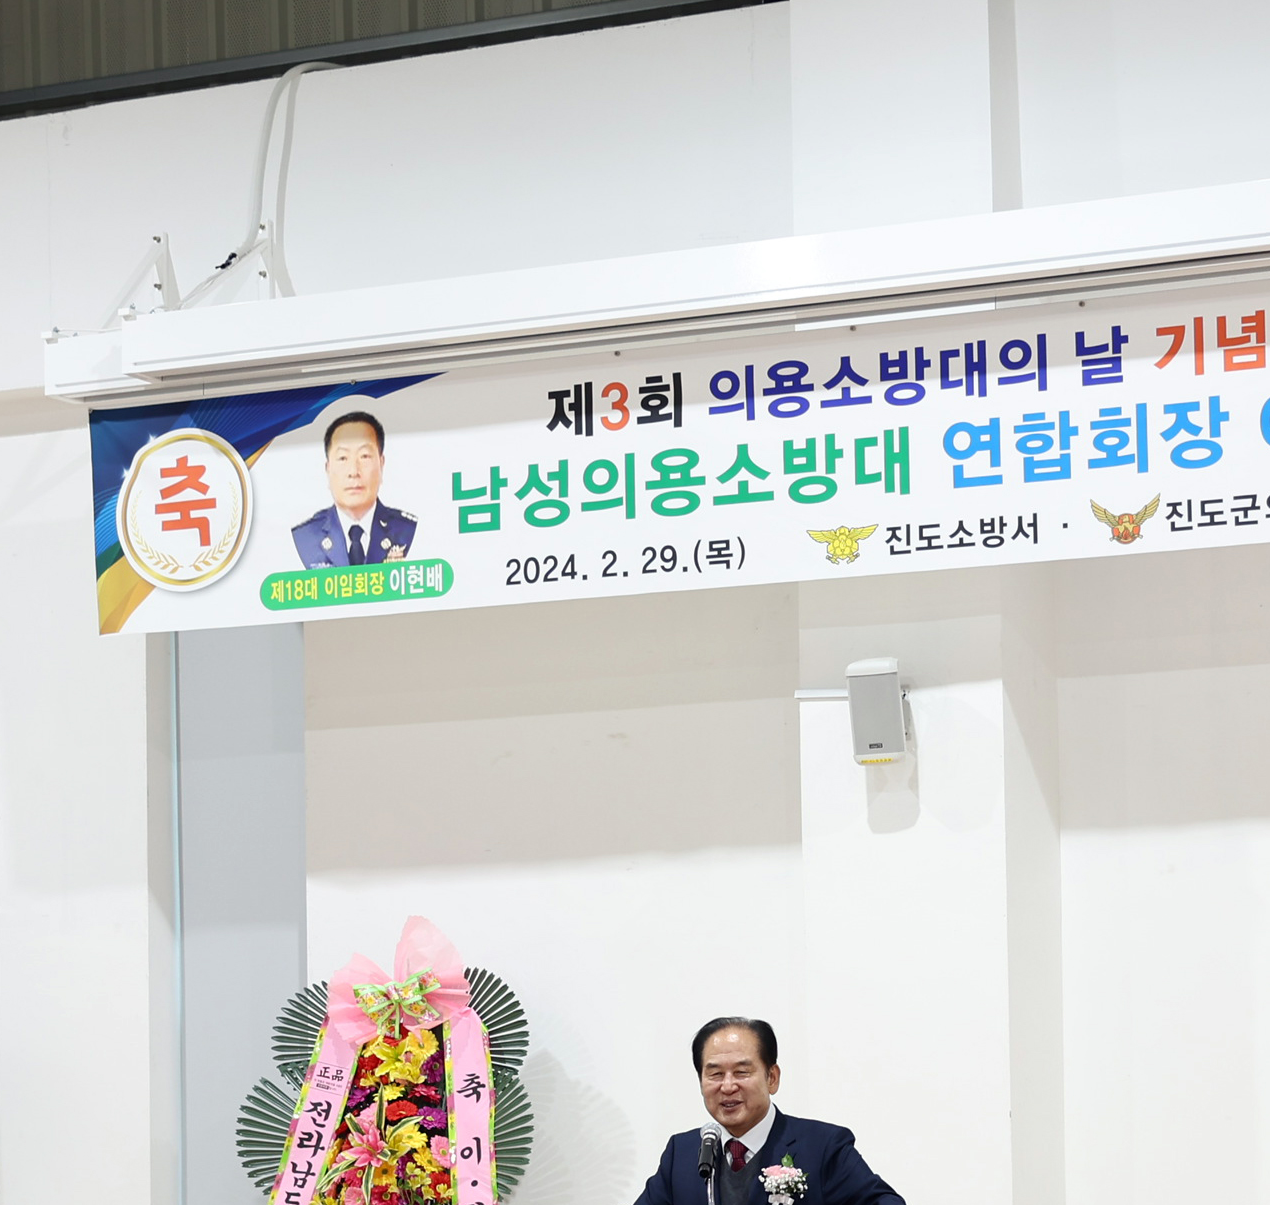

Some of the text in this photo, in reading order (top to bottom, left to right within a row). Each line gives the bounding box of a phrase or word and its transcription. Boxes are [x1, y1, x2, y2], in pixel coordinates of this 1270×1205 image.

[546, 371, 684, 437] 제3회
[708, 325, 1048, 421] 의용소방대의
[1075, 325, 1129, 382] 날
[452, 426, 911, 534] 남성의용소방대
[942, 395, 1230, 490] 연합회장
[154, 455, 217, 547] 축
[884, 513, 1039, 555] 진도소방서
[270, 563, 443, 604] 제18대 이임회장 이현배
[505, 553, 588, 586] 2024.
[601, 549, 629, 578] 2.
[316, 1066, 344, 1082] 正品
[456, 1072, 486, 1103] 축
